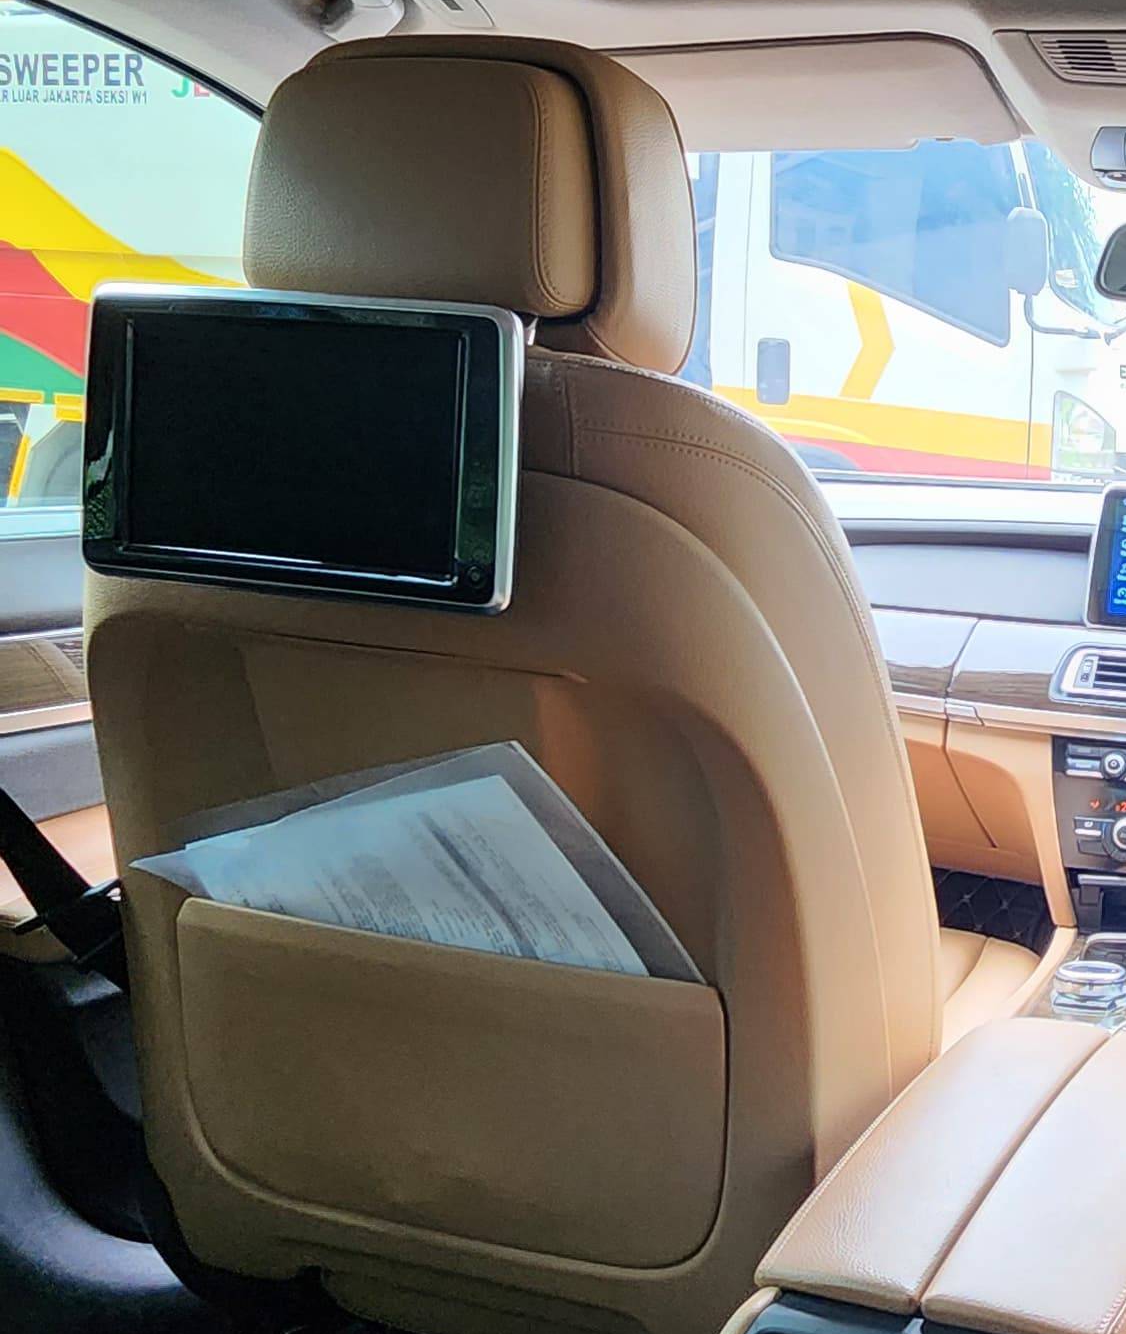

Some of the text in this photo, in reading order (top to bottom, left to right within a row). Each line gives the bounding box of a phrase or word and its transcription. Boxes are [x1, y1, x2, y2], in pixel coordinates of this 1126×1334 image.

[0, 53, 144, 86] SWEEPER
[12, 90, 39, 103] LUAR
[43, 89, 92, 104] JAKARTA
[96, 90, 128, 104] SEKSI
[132, 90, 147, 104] W1
